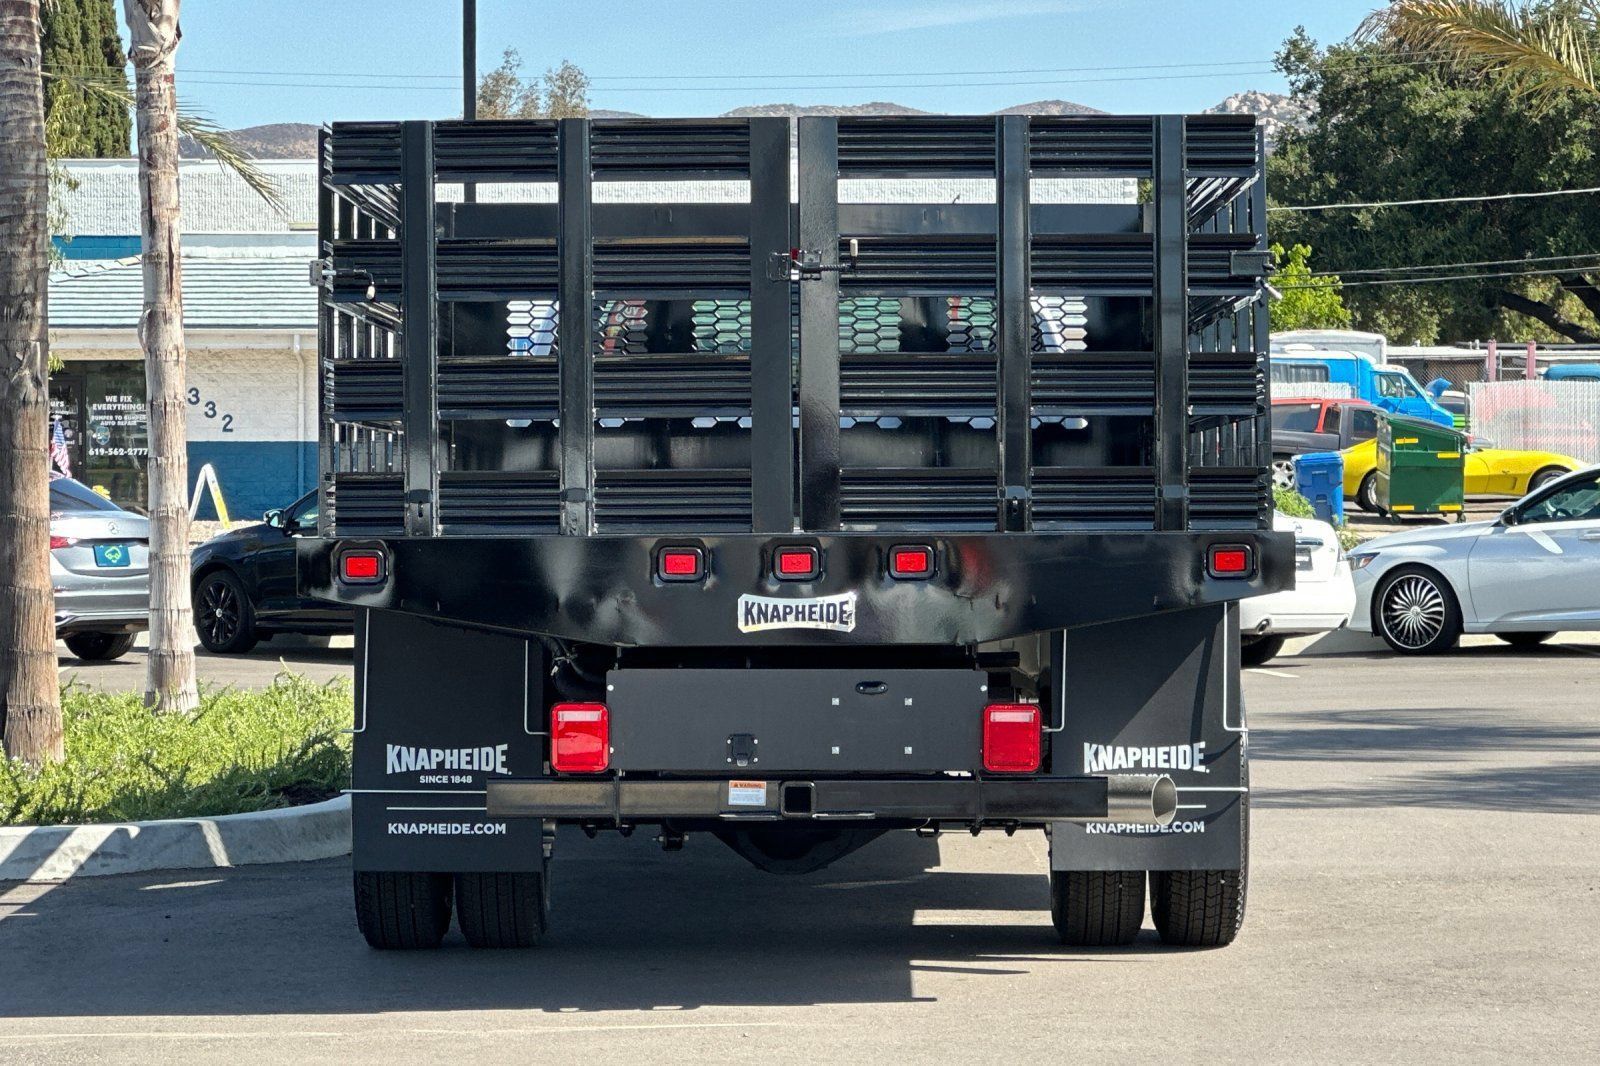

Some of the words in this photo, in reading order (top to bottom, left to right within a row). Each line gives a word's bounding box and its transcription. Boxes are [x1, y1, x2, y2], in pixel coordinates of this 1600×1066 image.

[92, 403, 145, 411] EVERYTHING!
[88, 447, 149, 456] 619-562-2777
[744, 600, 849, 627] KNAPHEIDE
[386, 743, 509, 775] KNAPHEIDE
[1083, 741, 1207, 774] KNAPHEIDE
[419, 775, 449, 784] SINCE
[451, 775, 473, 784] 1848
[387, 823, 507, 835] KNAPHEIDE.COM
